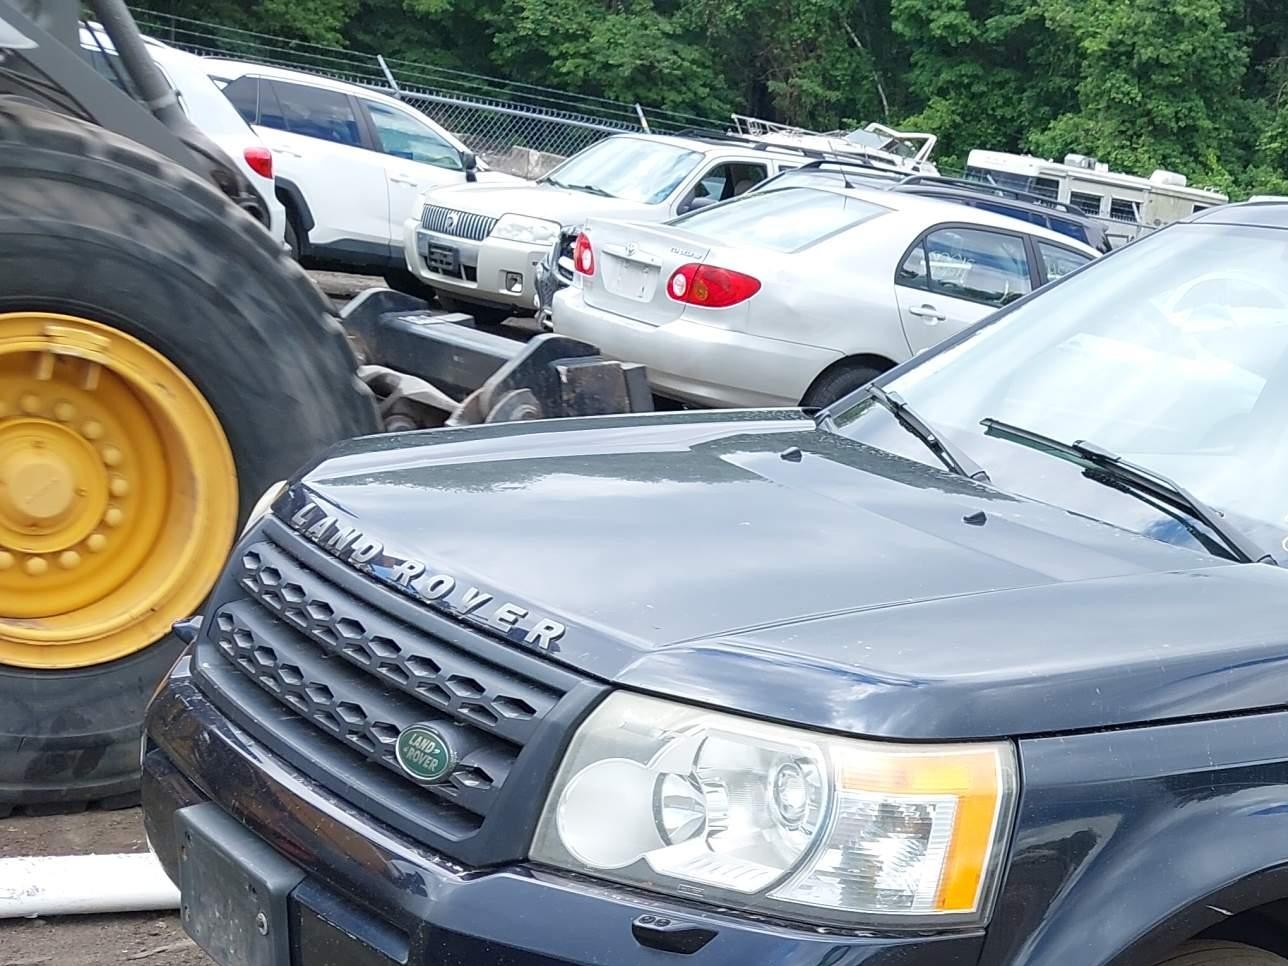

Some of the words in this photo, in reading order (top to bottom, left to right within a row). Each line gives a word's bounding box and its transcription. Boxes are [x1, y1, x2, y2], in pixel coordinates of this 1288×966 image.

[291, 502, 384, 563] LAND
[391, 559, 567, 650] ROVER
[408, 733, 436, 753] LAND
[406, 747, 439, 772] ROVER
